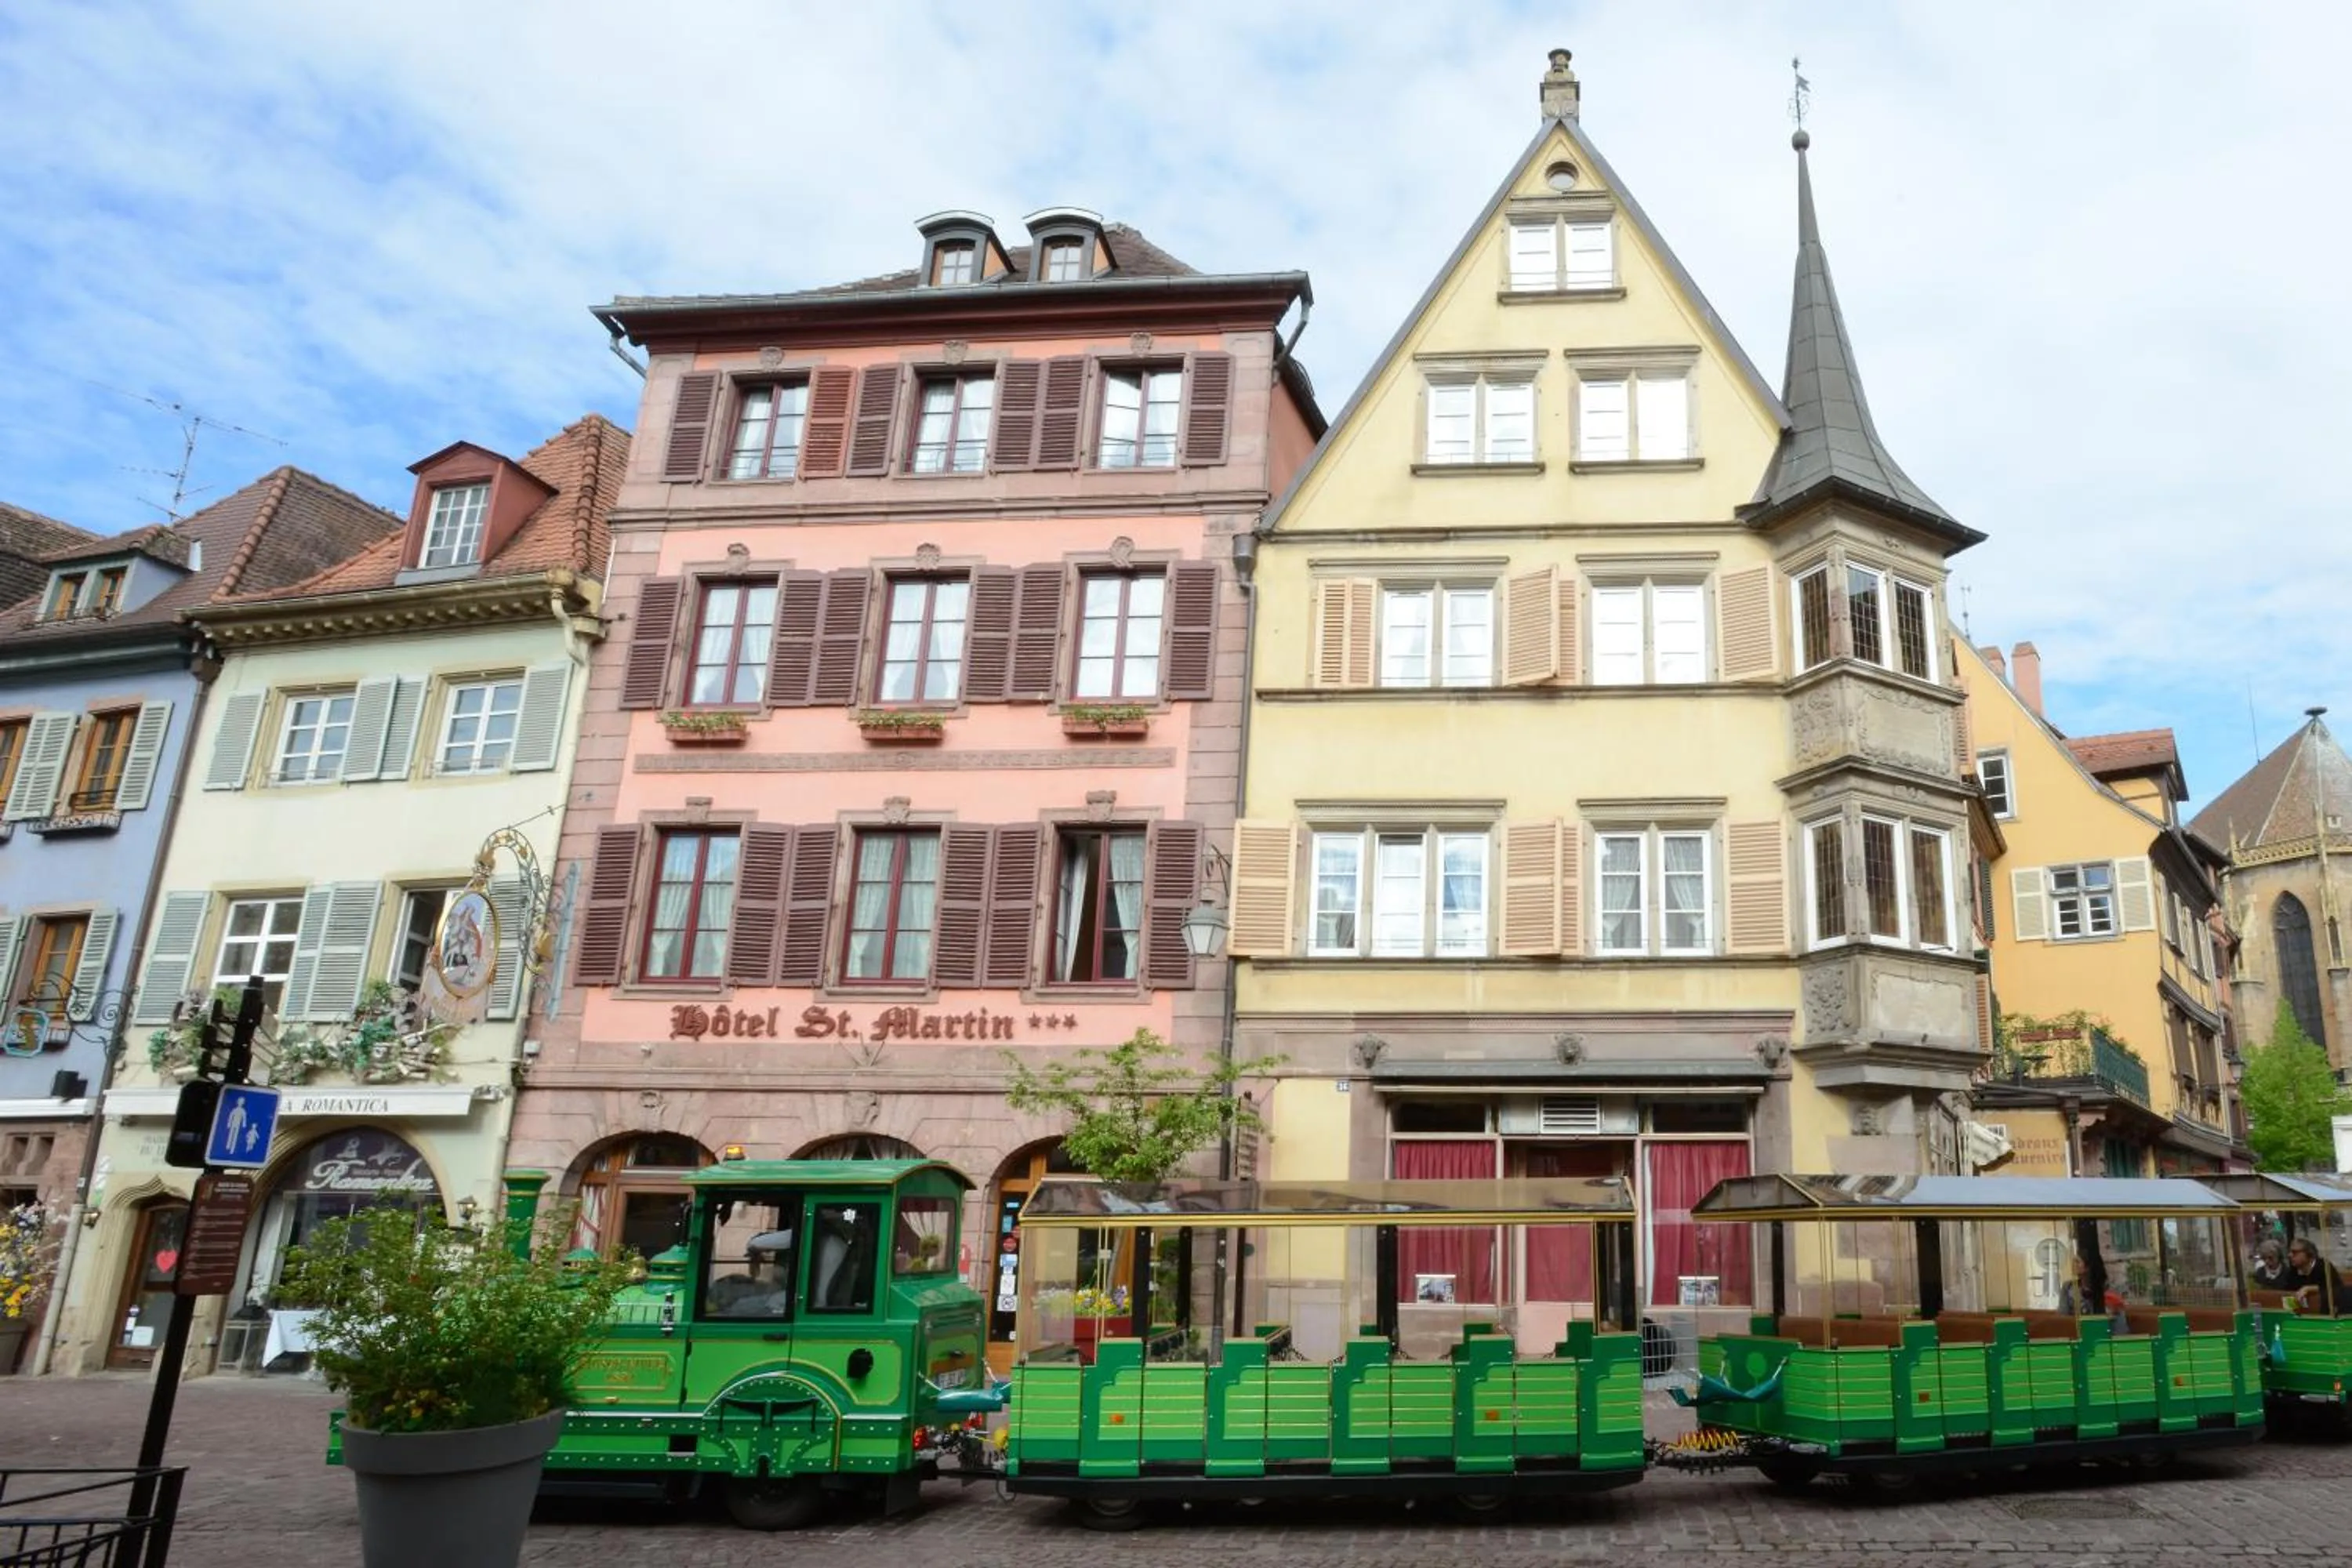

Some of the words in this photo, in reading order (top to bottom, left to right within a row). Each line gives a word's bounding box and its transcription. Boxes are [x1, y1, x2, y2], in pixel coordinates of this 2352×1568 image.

[670, 1004, 779, 1041] Hôtel
[794, 1006, 860, 1038] St.
[869, 1006, 1014, 1041] Martin
[303, 1098, 389, 1112] ROMANTICA
